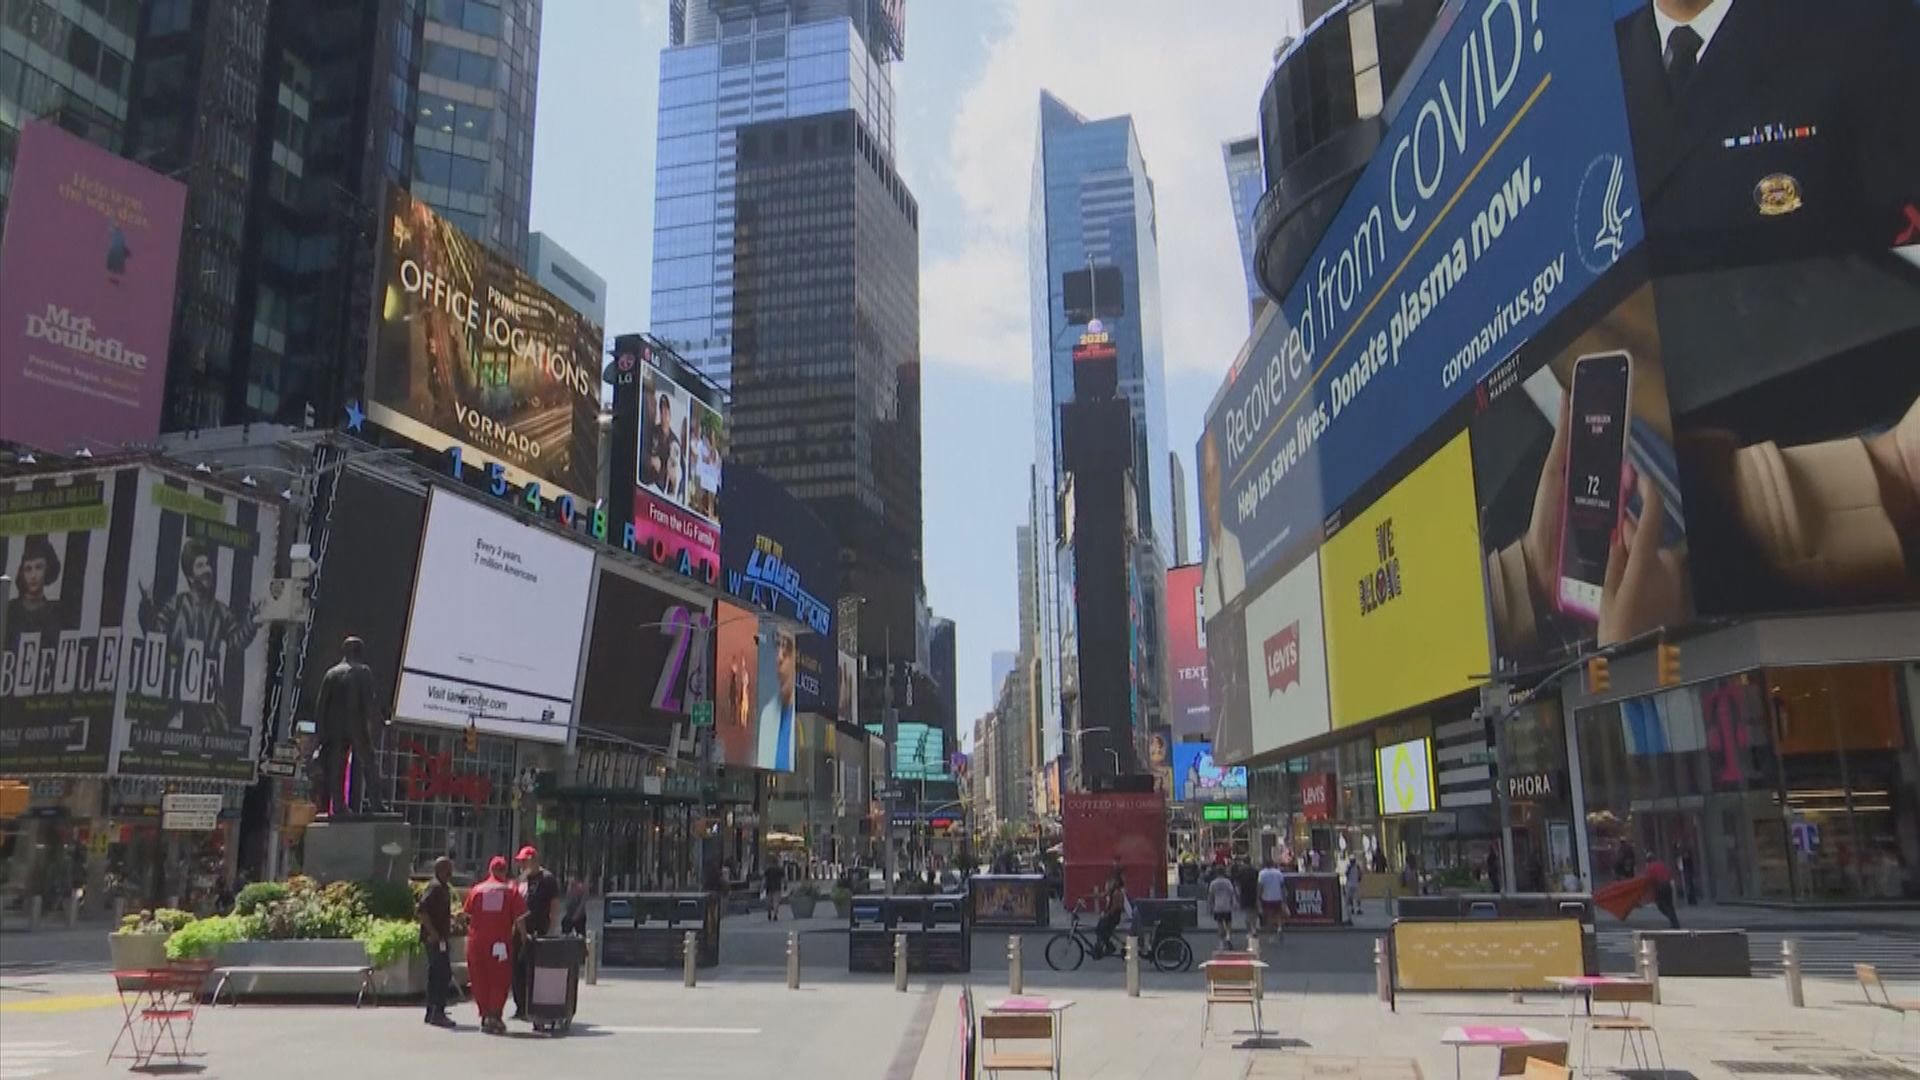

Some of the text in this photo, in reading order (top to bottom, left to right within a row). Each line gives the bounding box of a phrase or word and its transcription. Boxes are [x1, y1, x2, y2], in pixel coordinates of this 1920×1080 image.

[1226, 288, 1316, 468] Recovered
[1316, 204, 1386, 341] from
[1390, 0, 1544, 232] COVID!
[47, 302, 96, 332] Mrs.
[400, 259, 479, 331] OFFICE
[488, 286, 521, 321] PRIME
[25, 313, 148, 370] Doubtfire
[1080, 332, 1108, 345] 2020
[1238, 480, 1258, 523] Help
[1257, 468, 1270, 499] us
[1270, 443, 1298, 486] save
[1298, 408, 1330, 463] lives.
[1330, 324, 1388, 417] Donate
[1390, 242, 1468, 366] plasma
[1472, 155, 1542, 261] now.
[1442, 252, 1565, 388] coronavirus.gov
[485, 309, 589, 396] LOCATIONS
[618, 374, 633, 383] LG
[455, 401, 541, 458] VORNADO
[1587, 475, 1600, 496] 72
[476, 537, 496, 556] Every
[649, 502, 716, 551] From the LG Family
[474, 552, 538, 584] 7 million Americans
[747, 548, 800, 598] LOWER
[427, 684, 446, 701] Visit
